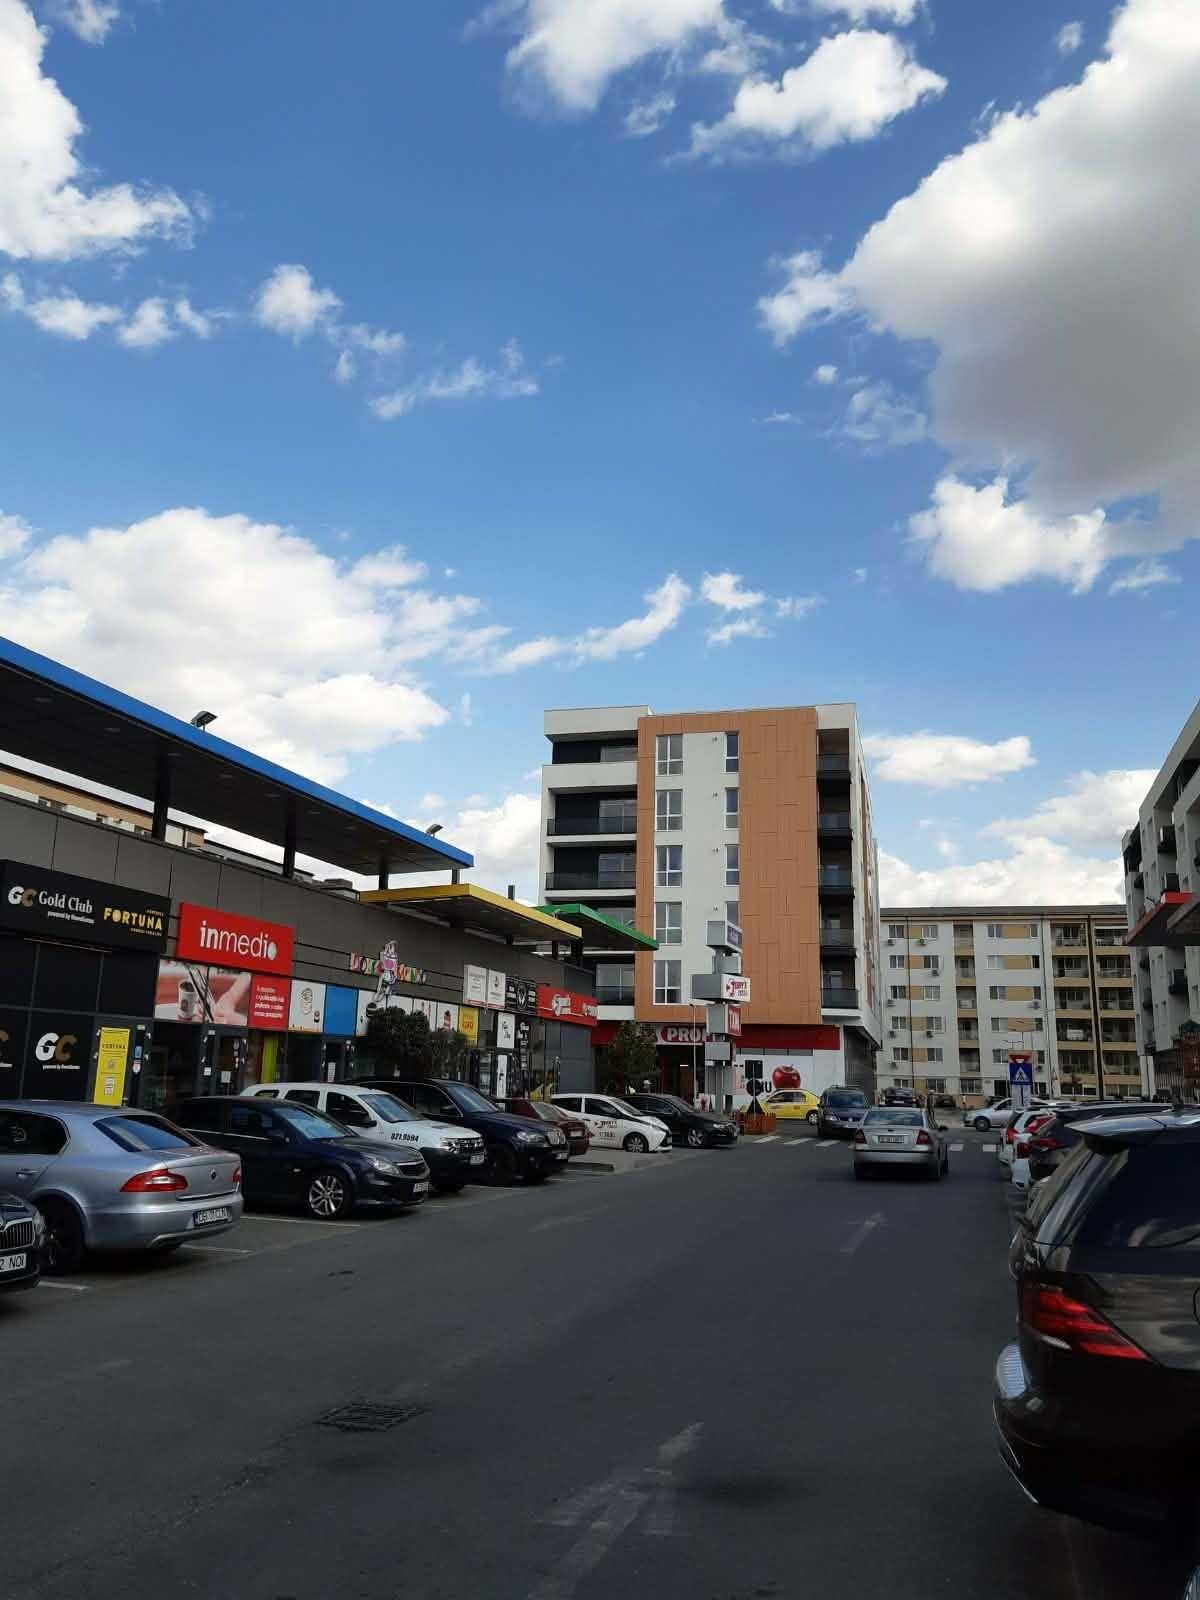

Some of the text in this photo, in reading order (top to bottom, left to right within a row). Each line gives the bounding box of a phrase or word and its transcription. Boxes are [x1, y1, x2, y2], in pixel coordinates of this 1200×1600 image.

[7, 886, 37, 907] GC
[38, 891, 93, 914] Gold Club
[104, 907, 162, 930] FORTUNA
[200, 919, 278, 960] inmedio
[36, 1032, 78, 1062] GC
